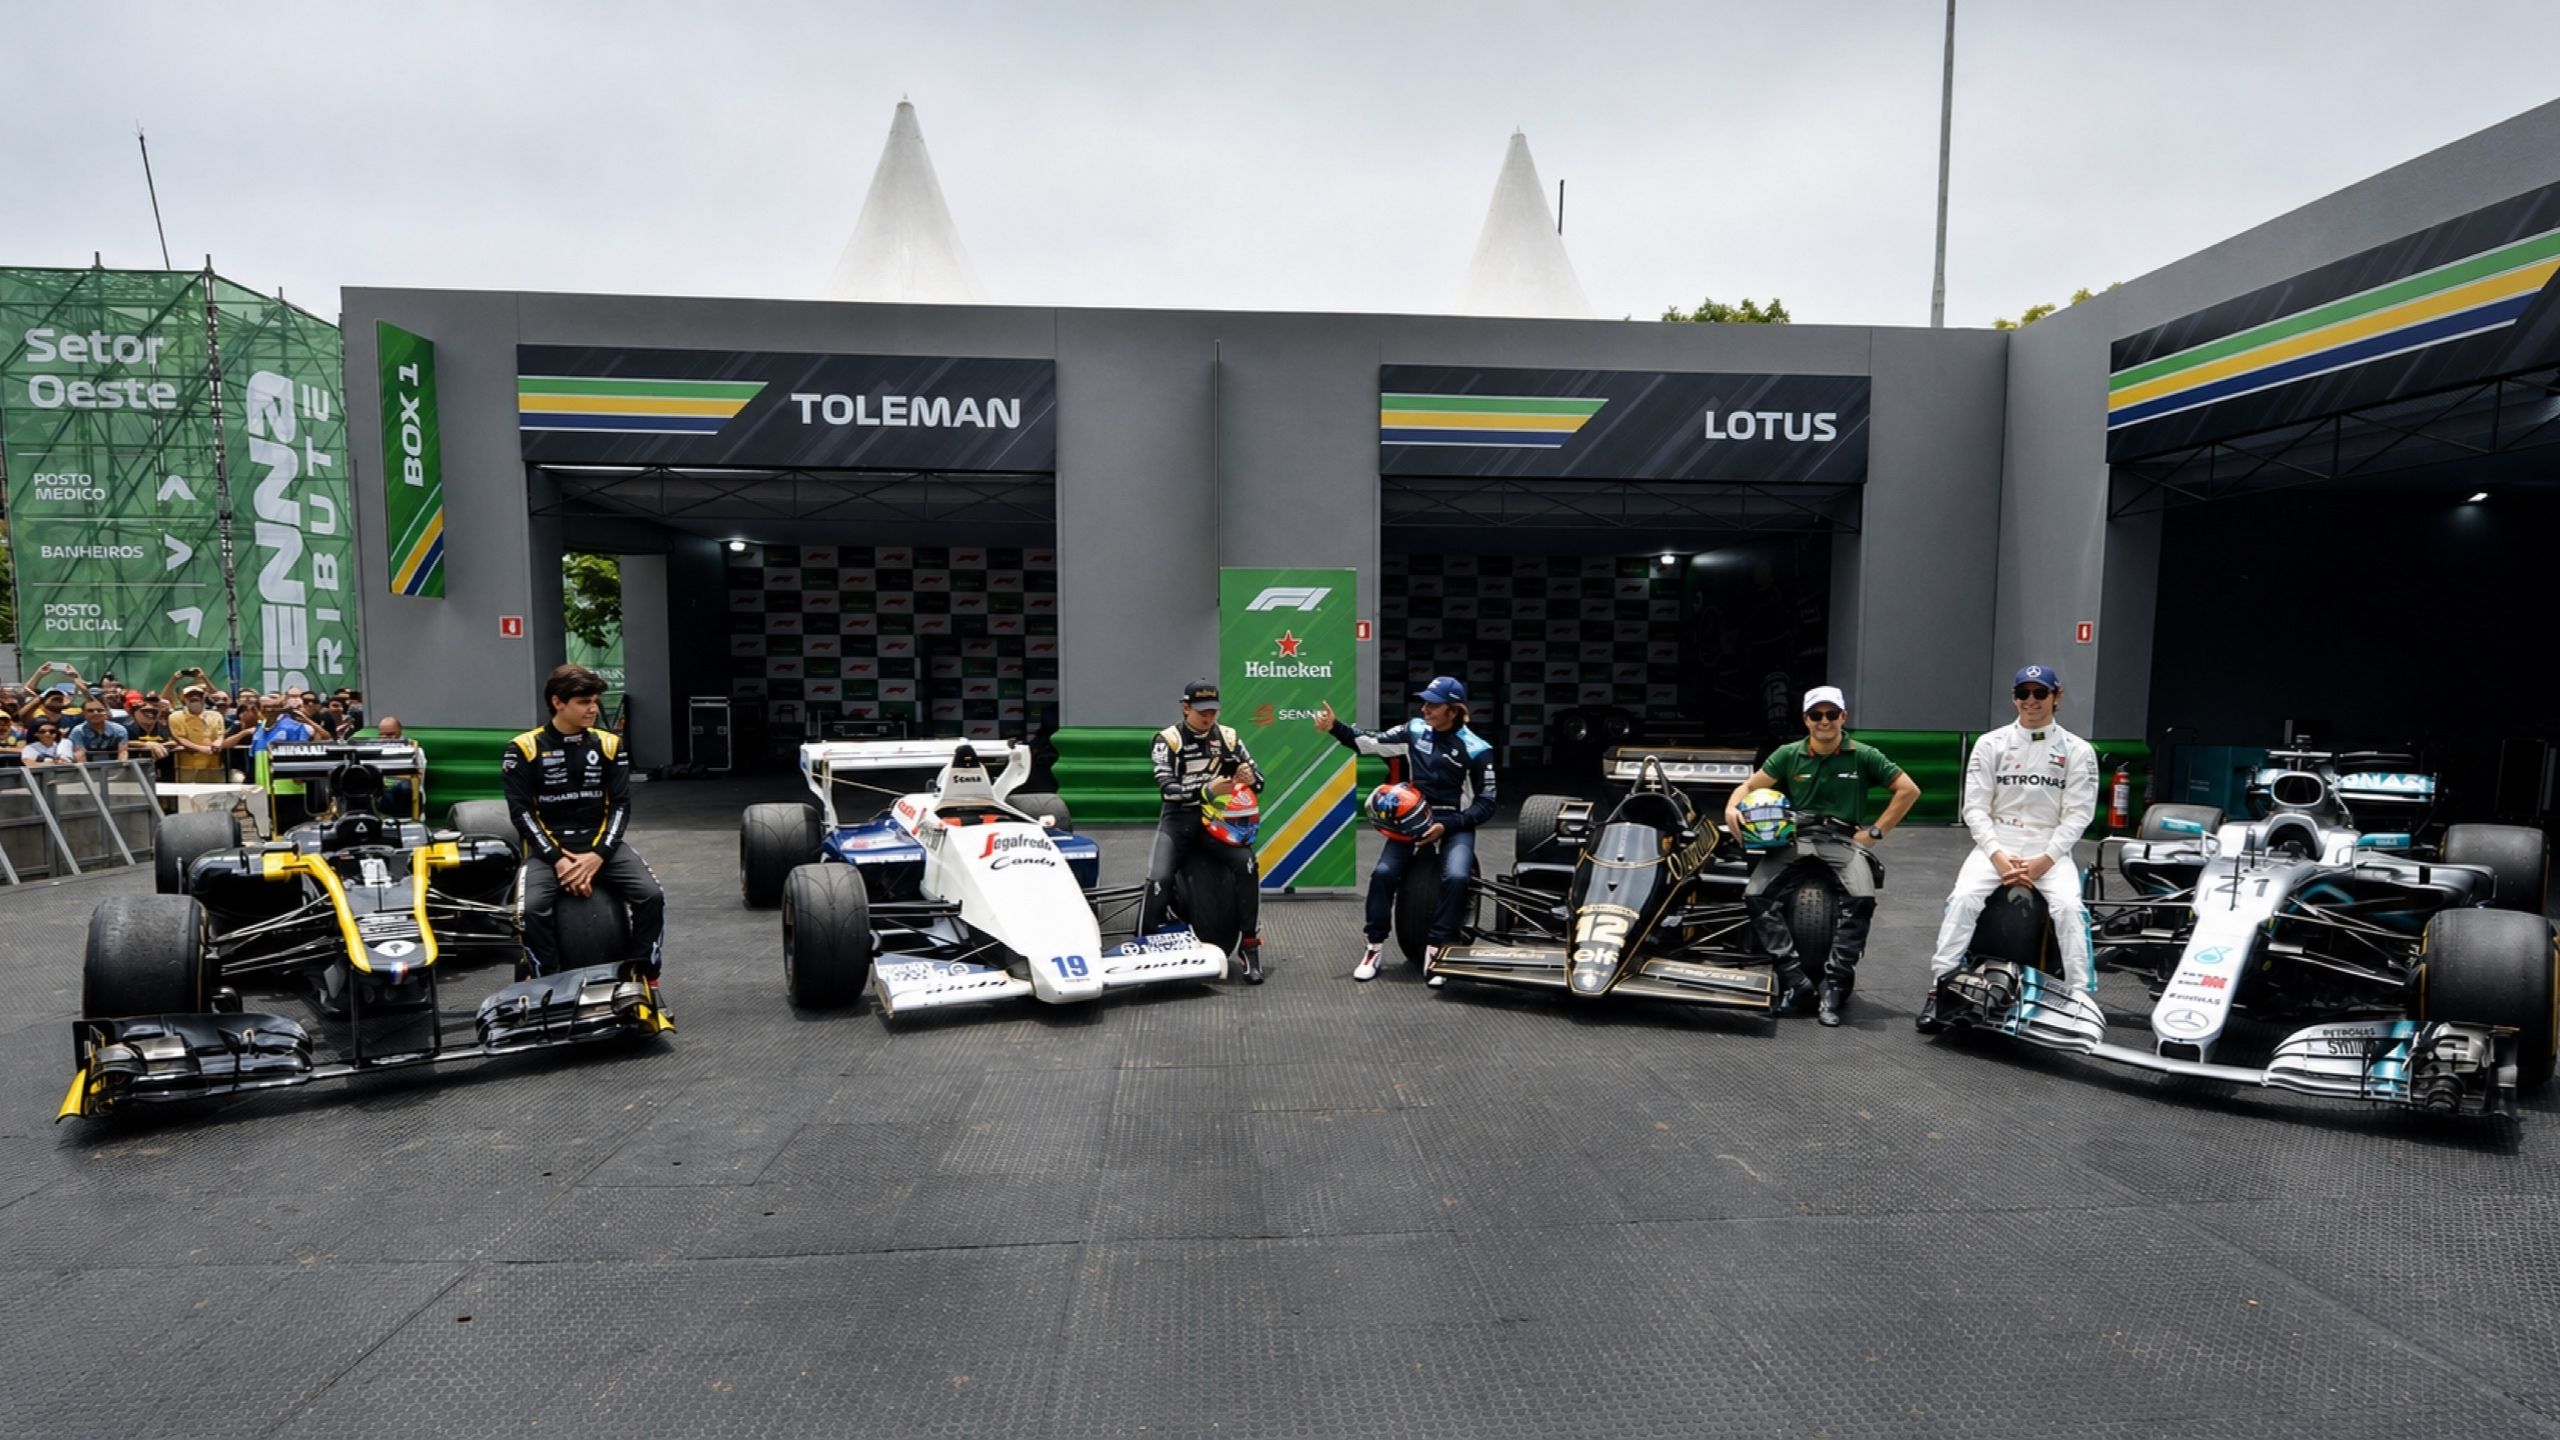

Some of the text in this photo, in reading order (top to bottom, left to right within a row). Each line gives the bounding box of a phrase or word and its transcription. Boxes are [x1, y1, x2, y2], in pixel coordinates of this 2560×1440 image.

[26, 328, 165, 364] Setor
[28, 374, 177, 409] Oeste
[791, 392, 1021, 428] TOLEMAN
[398, 362, 424, 487] BOX 1
[1705, 411, 1838, 442] LOTUS
[34, 473, 92, 486] POSTO
[35, 487, 105, 501] MEDICO
[41, 545, 144, 559] BANHEIROS
[44, 603, 101, 617] POSTO
[45, 618, 123, 632] POLICIAL
[1245, 661, 1332, 678] Heineken
[1996, 774, 2066, 789] PETRONAS
[1575, 913, 1631, 948] 12
[1051, 955, 1089, 978] 19
